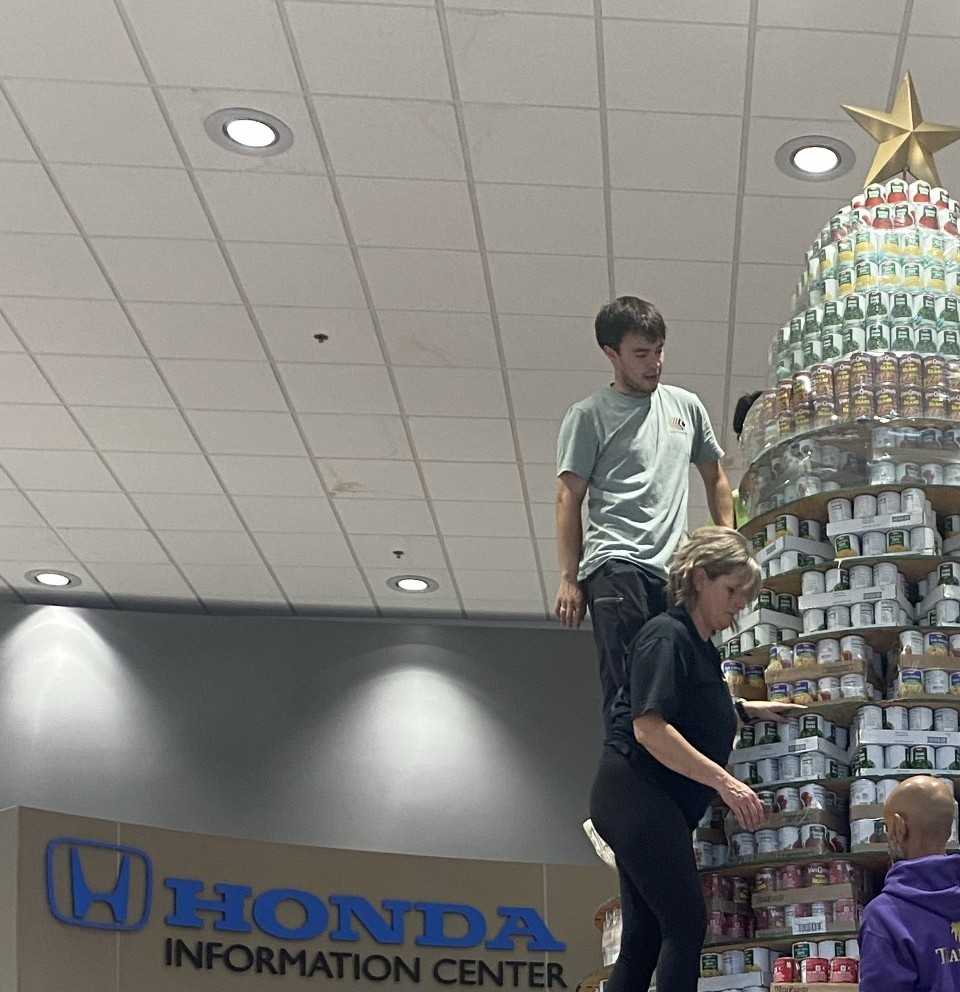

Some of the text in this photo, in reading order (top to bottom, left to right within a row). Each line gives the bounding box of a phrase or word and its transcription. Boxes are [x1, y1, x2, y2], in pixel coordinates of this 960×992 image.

[164, 878, 567, 951] HONDA
[165, 938, 568, 989] INFORMATION CENTER
